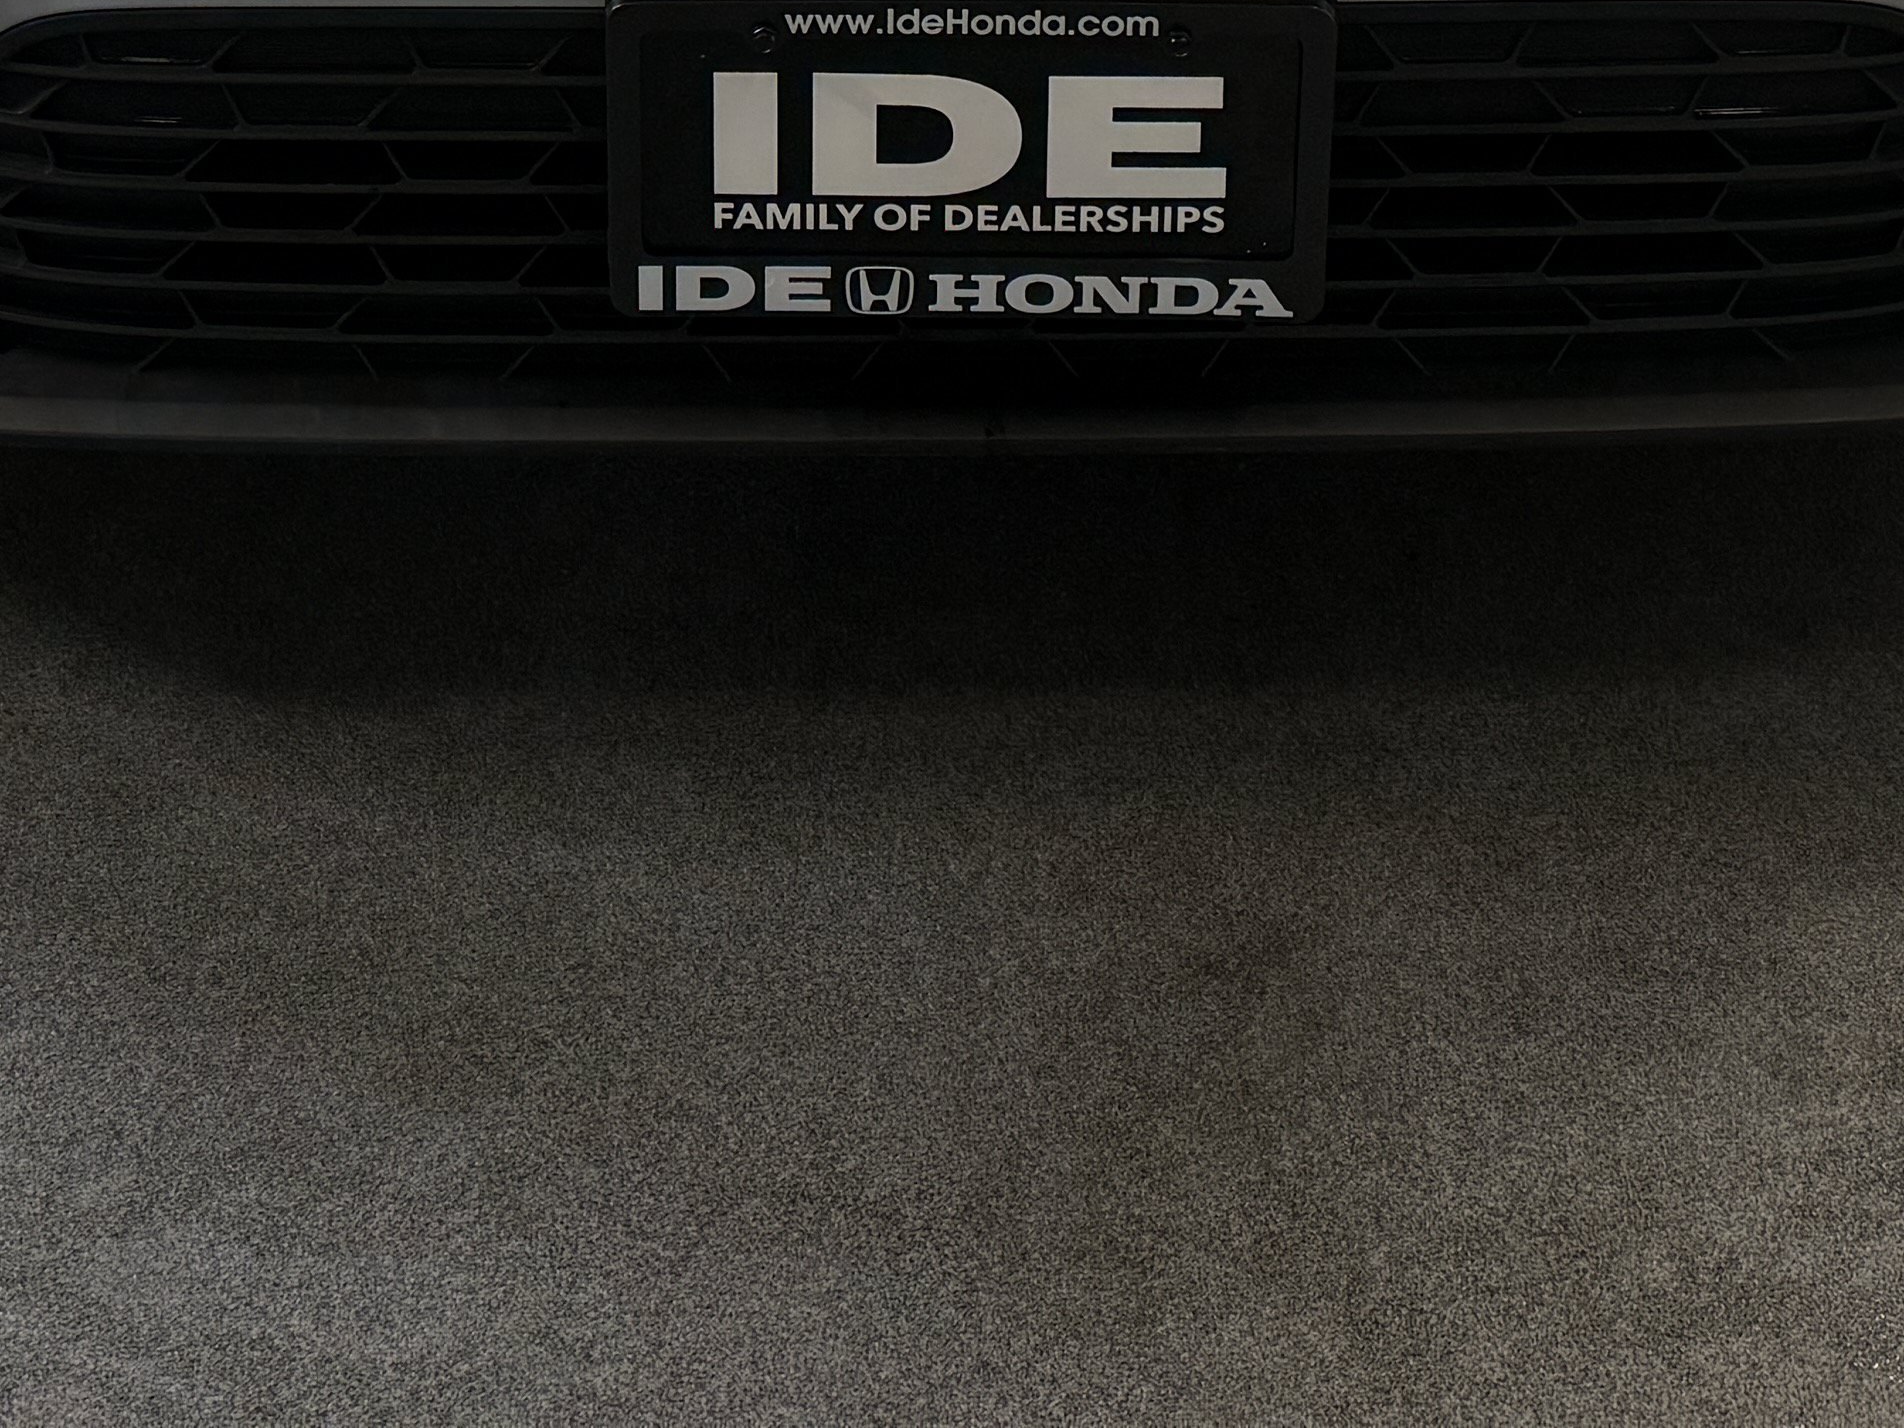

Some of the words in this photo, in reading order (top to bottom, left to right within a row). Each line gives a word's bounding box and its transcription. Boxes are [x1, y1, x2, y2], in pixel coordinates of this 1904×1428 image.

[785, 9, 1158, 36] www.IdeHonda.com
[713, 72, 1226, 198] IDE
[714, 203, 863, 230] FAMILY
[874, 204, 930, 231] OF
[945, 205, 1224, 233] DEALERSHIPS
[638, 266, 831, 311] IDE
[929, 274, 1293, 317] HONDA
